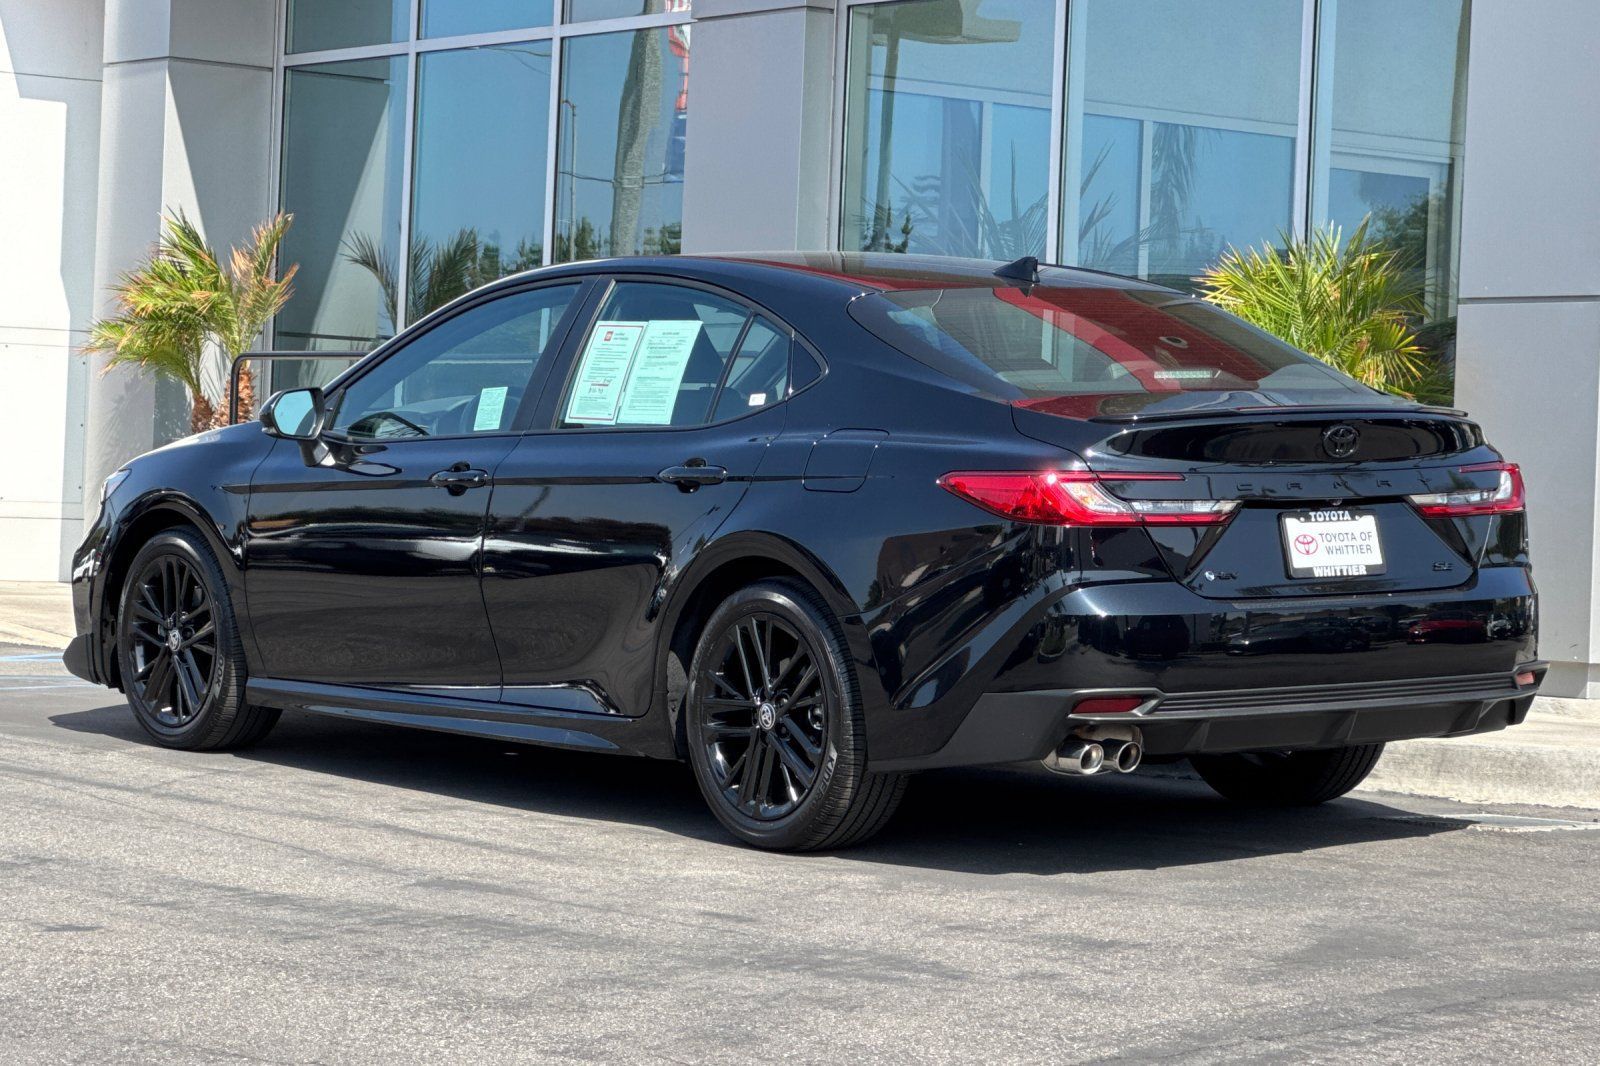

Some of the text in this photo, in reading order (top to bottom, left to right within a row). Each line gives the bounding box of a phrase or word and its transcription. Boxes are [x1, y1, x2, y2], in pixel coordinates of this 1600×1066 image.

[1236, 476, 1432, 491] CAMRY
[1309, 510, 1352, 522] TOYOTA
[1318, 531, 1373, 543] TOYOTA OF
[1325, 544, 1373, 555] WHITTIER
[1313, 565, 1367, 577] WHITTIER
